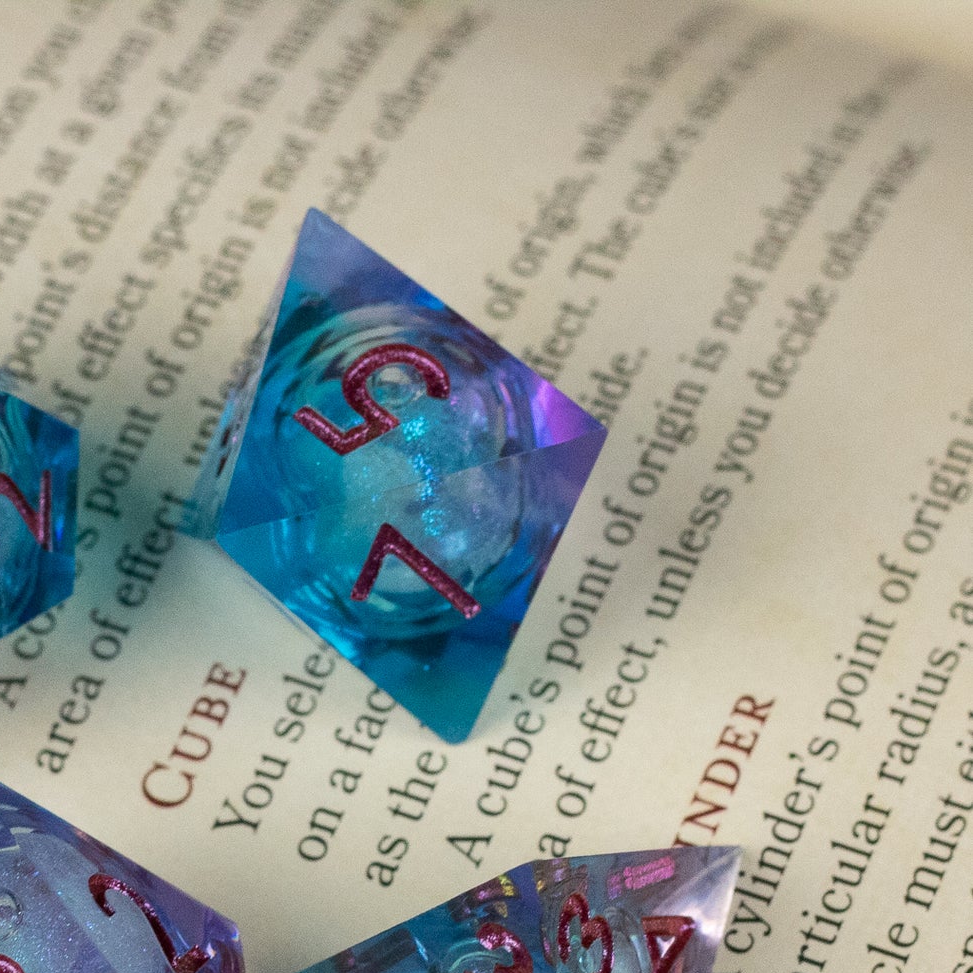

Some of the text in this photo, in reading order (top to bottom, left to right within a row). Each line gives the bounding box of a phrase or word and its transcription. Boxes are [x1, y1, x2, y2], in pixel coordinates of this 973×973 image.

[4, 94, 186, 393] point's distance
[71, 274, 153, 391] effect
[138, 114, 254, 271] specifies
[159, 238, 253, 369] origin
[567, 217, 641, 282] The
[144, 350, 186, 401] of
[293, 344, 451, 456] 5
[351, 522, 482, 620] 7
[445, 339, 730, 869] A cube's point of origin is
[554, 764, 596, 819] of
[579, 611, 669, 764] effect,
[645, 485, 732, 620] unless
[712, 406, 773, 484] you
[746, 284, 837, 401] decide
[36, 606, 132, 774] area of
[141, 661, 248, 810] CUBE
[724, 553, 919, 957] cylinder's point of
[877, 641, 969, 786] radius,
[211, 754, 289, 834] You
[297, 768, 363, 863] on a
[365, 750, 447, 888] as the
[903, 795, 971, 911] must
